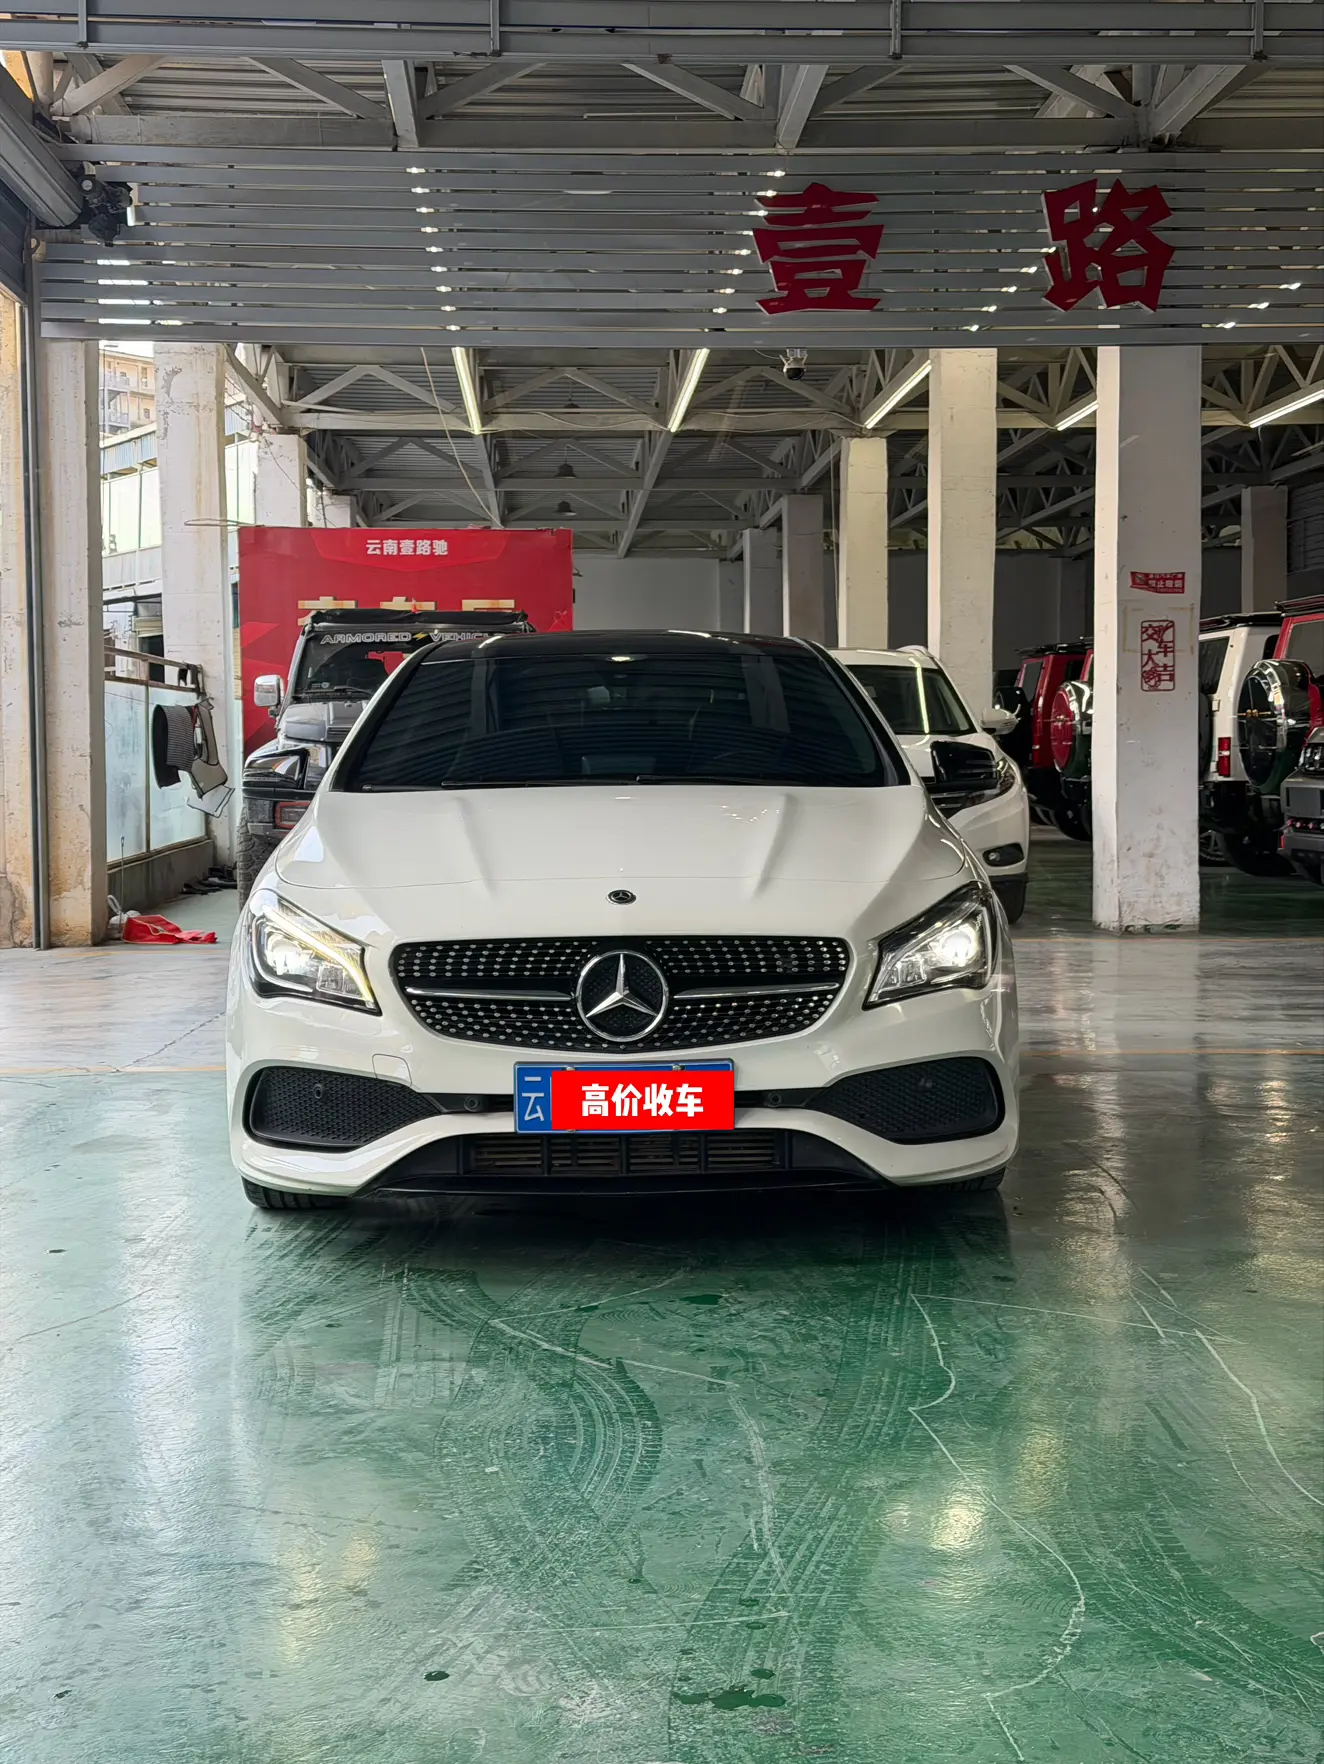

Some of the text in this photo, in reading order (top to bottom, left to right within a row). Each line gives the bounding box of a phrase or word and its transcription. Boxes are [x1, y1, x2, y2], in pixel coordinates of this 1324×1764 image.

[752, 178, 1174, 315] 壹路
[366, 540, 448, 556] 云南壹路驰
[320, 632, 411, 644] ARMORED
[521, 1076, 545, 1121] 云
